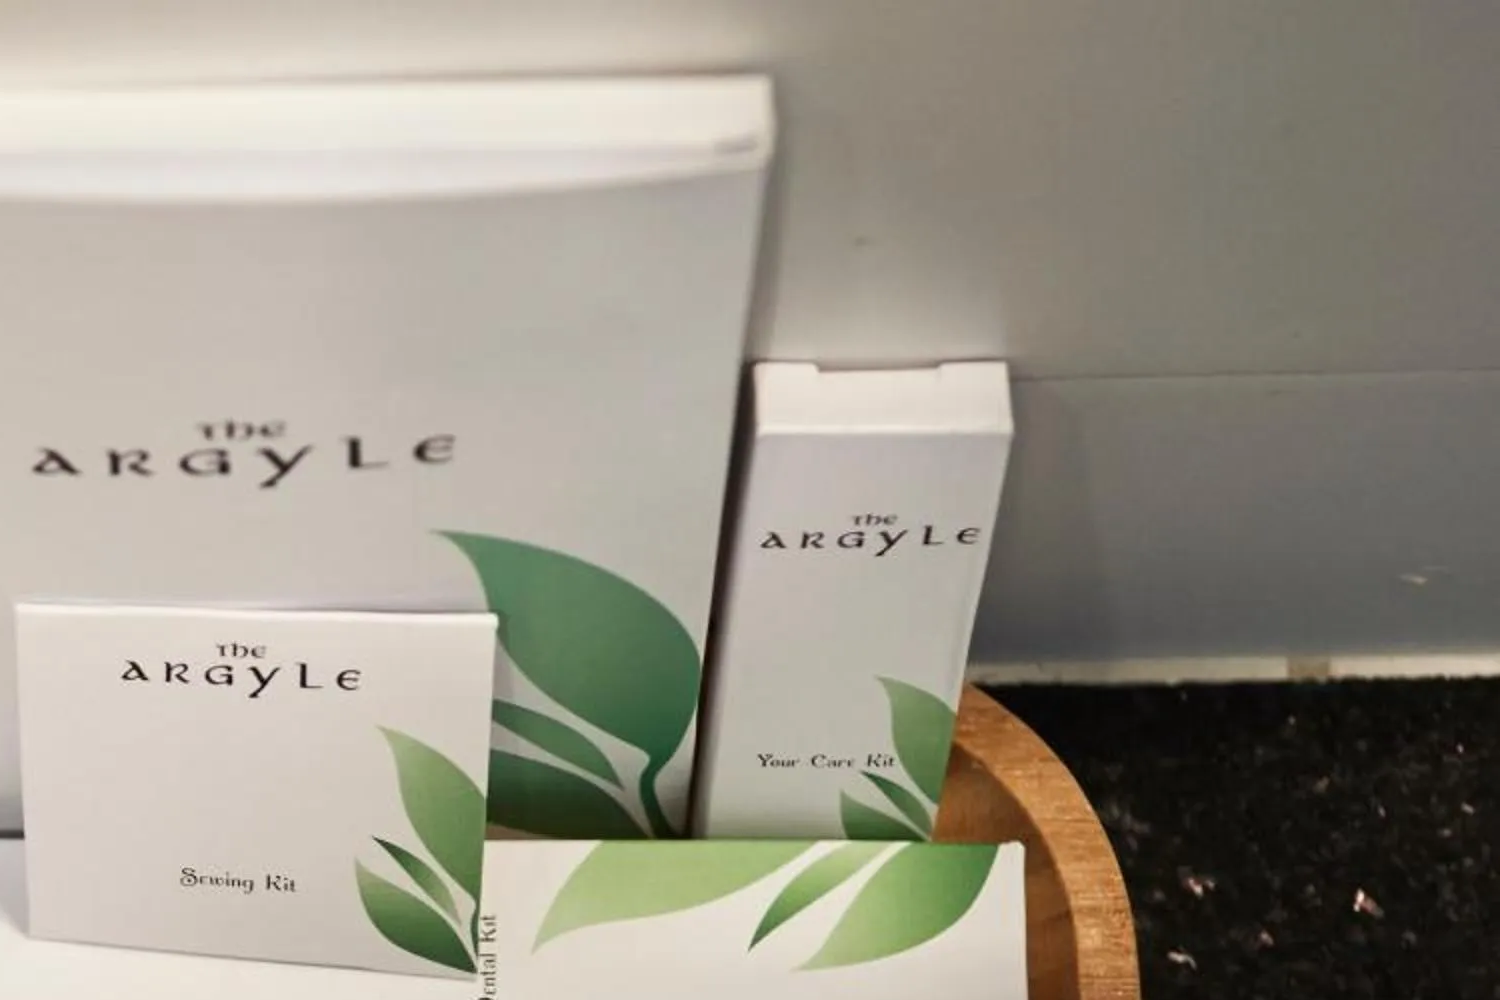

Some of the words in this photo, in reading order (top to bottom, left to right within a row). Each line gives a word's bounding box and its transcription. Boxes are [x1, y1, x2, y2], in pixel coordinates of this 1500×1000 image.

[31, 433, 458, 489] ARGYLE
[760, 524, 982, 557] ARGYLE
[120, 659, 364, 699] ARGYLE
[757, 753, 799, 768] Your
[810, 754, 852, 768] Care
[866, 752, 896, 769] Kit
[179, 867, 255, 895] Sewing
[265, 874, 296, 893] Kit
[480, 914, 497, 942] Kit
